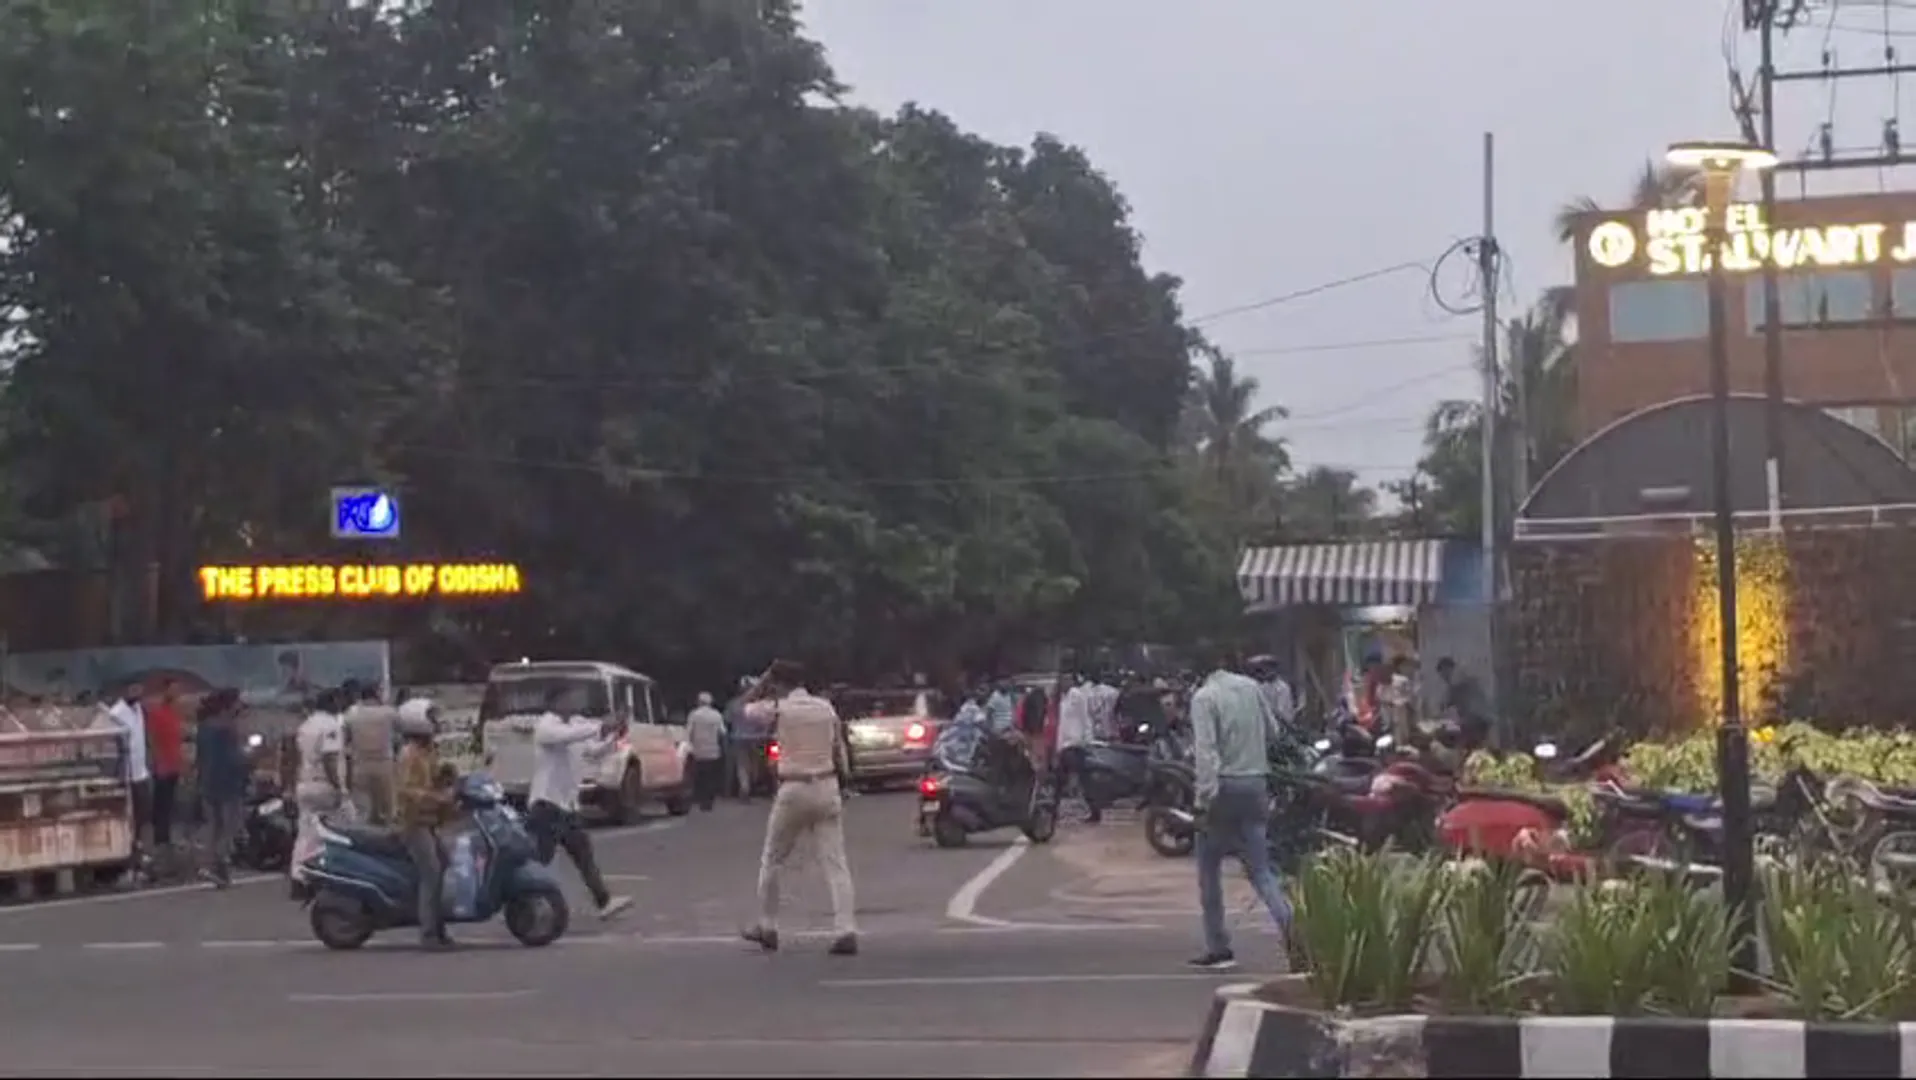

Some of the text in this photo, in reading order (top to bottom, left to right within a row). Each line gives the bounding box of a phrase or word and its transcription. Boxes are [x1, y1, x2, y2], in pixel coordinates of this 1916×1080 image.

[1646, 203, 1767, 237] HOEL
[200, 563, 520, 598] THE PRESS CLUB OF ODISHA
